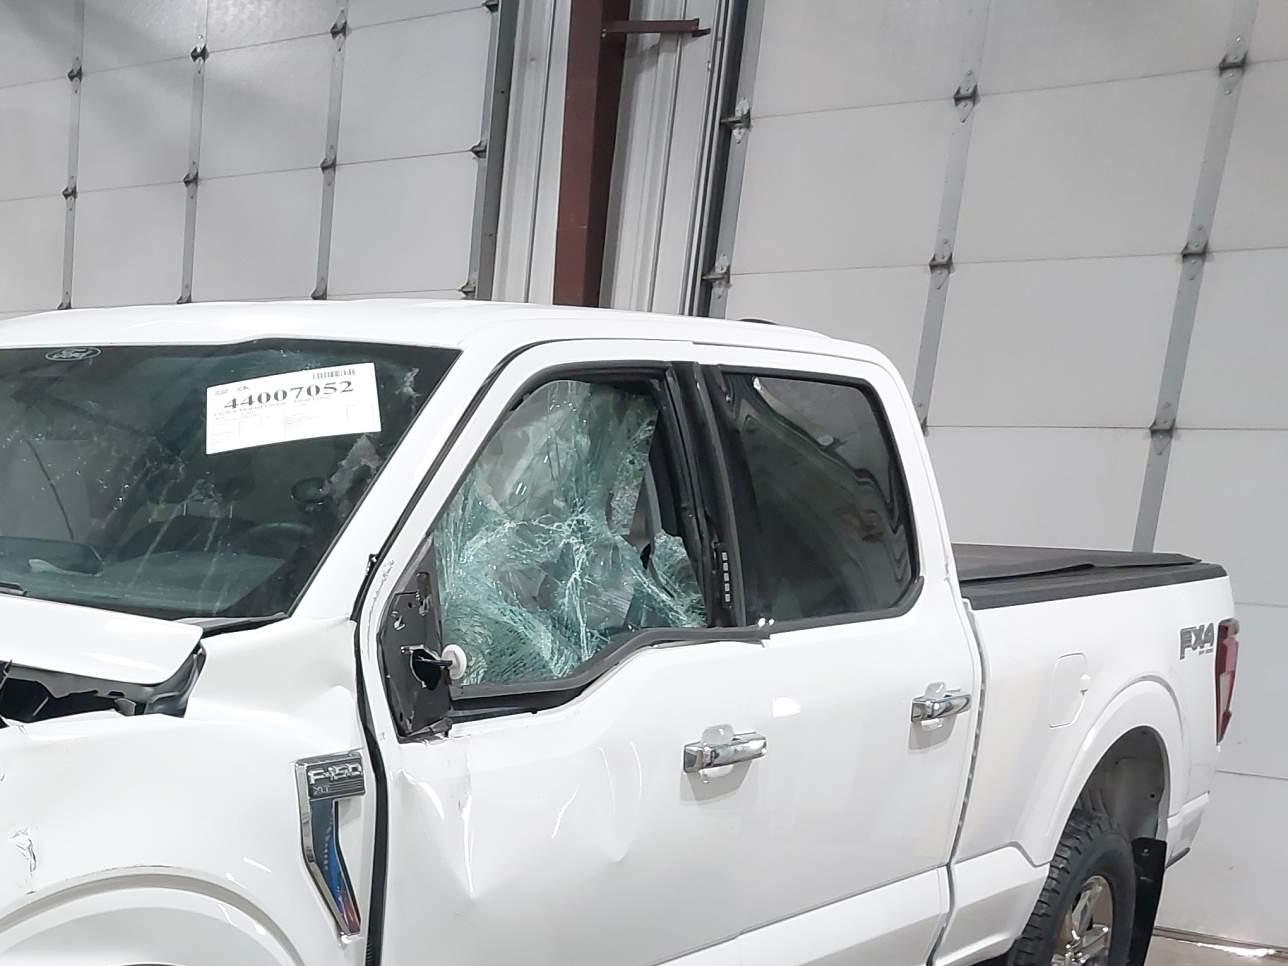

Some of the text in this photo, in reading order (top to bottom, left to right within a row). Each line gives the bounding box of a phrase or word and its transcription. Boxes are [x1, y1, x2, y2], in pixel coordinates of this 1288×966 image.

[224, 380, 355, 410] 44007052
[1179, 622, 1215, 660] FX4
[307, 763, 362, 785] F-150
